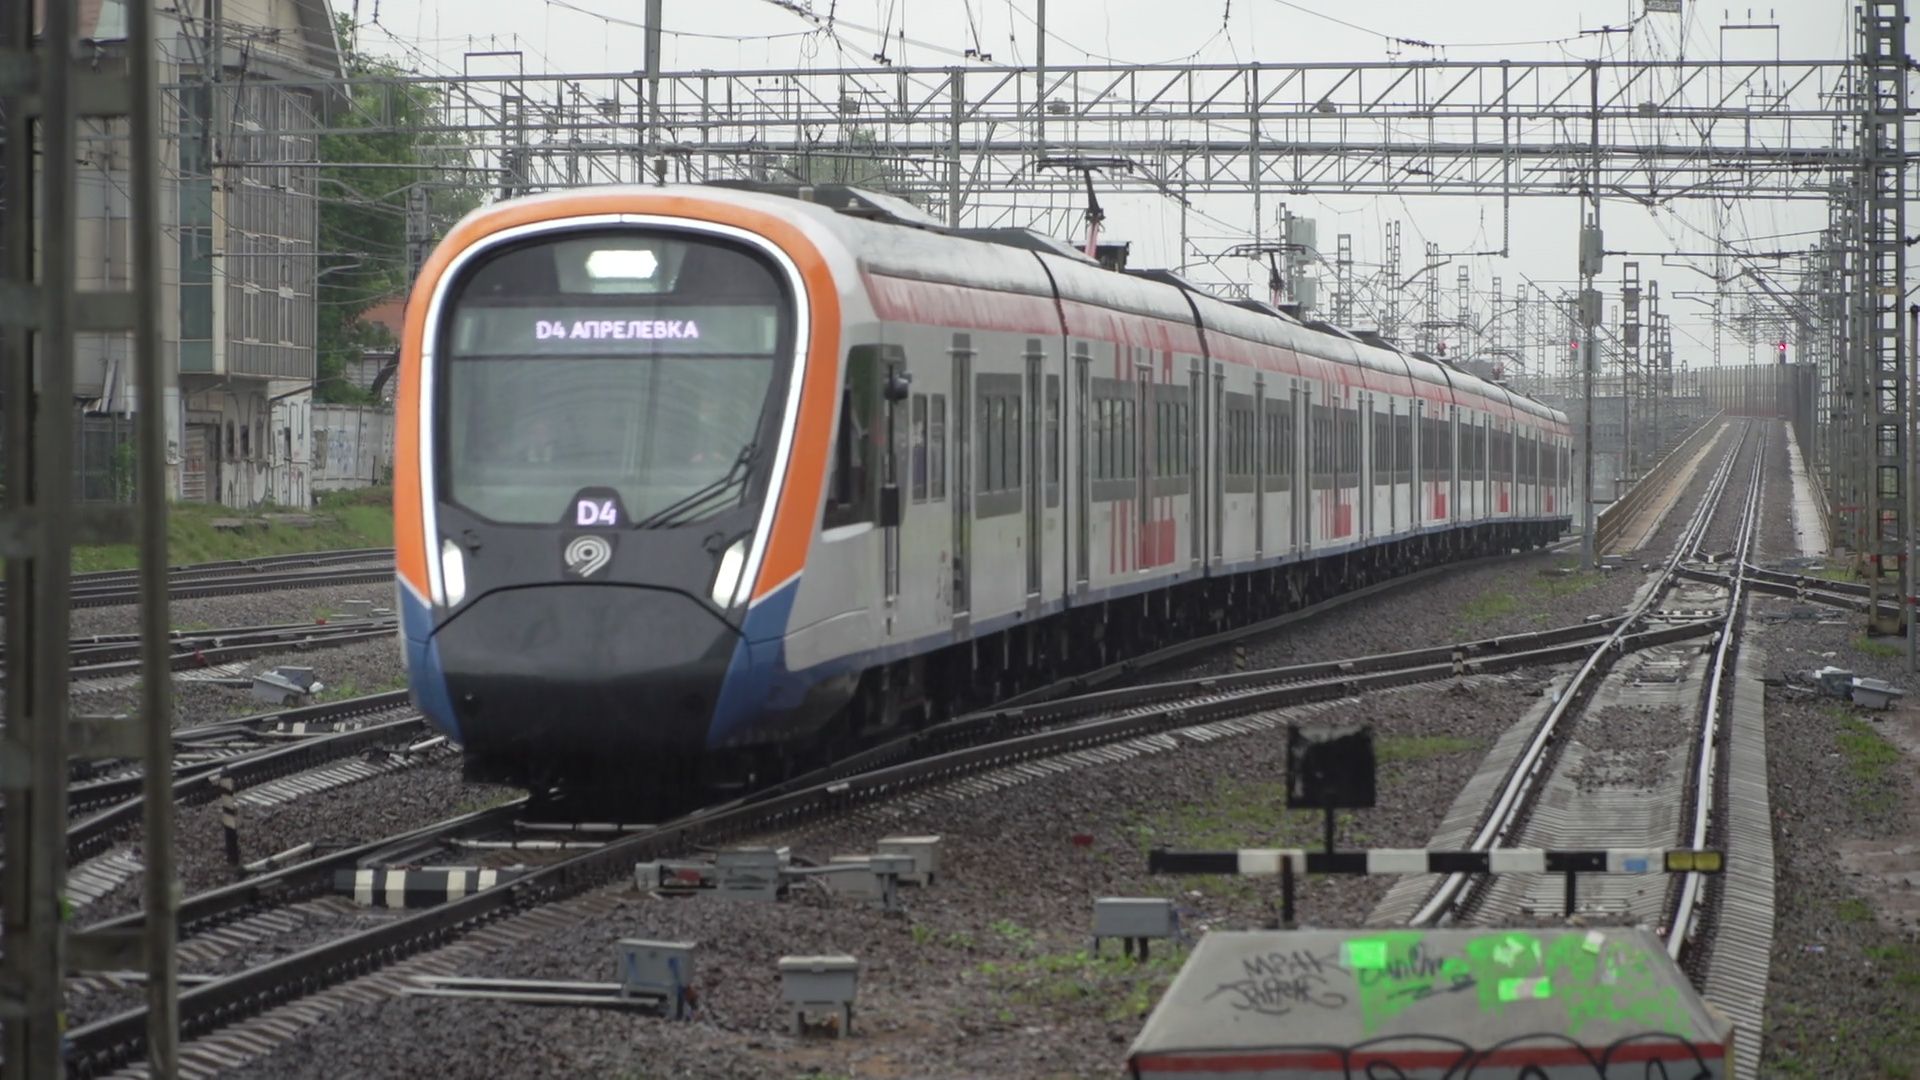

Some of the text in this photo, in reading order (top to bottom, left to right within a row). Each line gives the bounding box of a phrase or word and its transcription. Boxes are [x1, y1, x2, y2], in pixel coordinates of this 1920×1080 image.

[536, 320, 699, 339] D4 АПРЕЛЕВКА
[577, 500, 617, 525] D4
